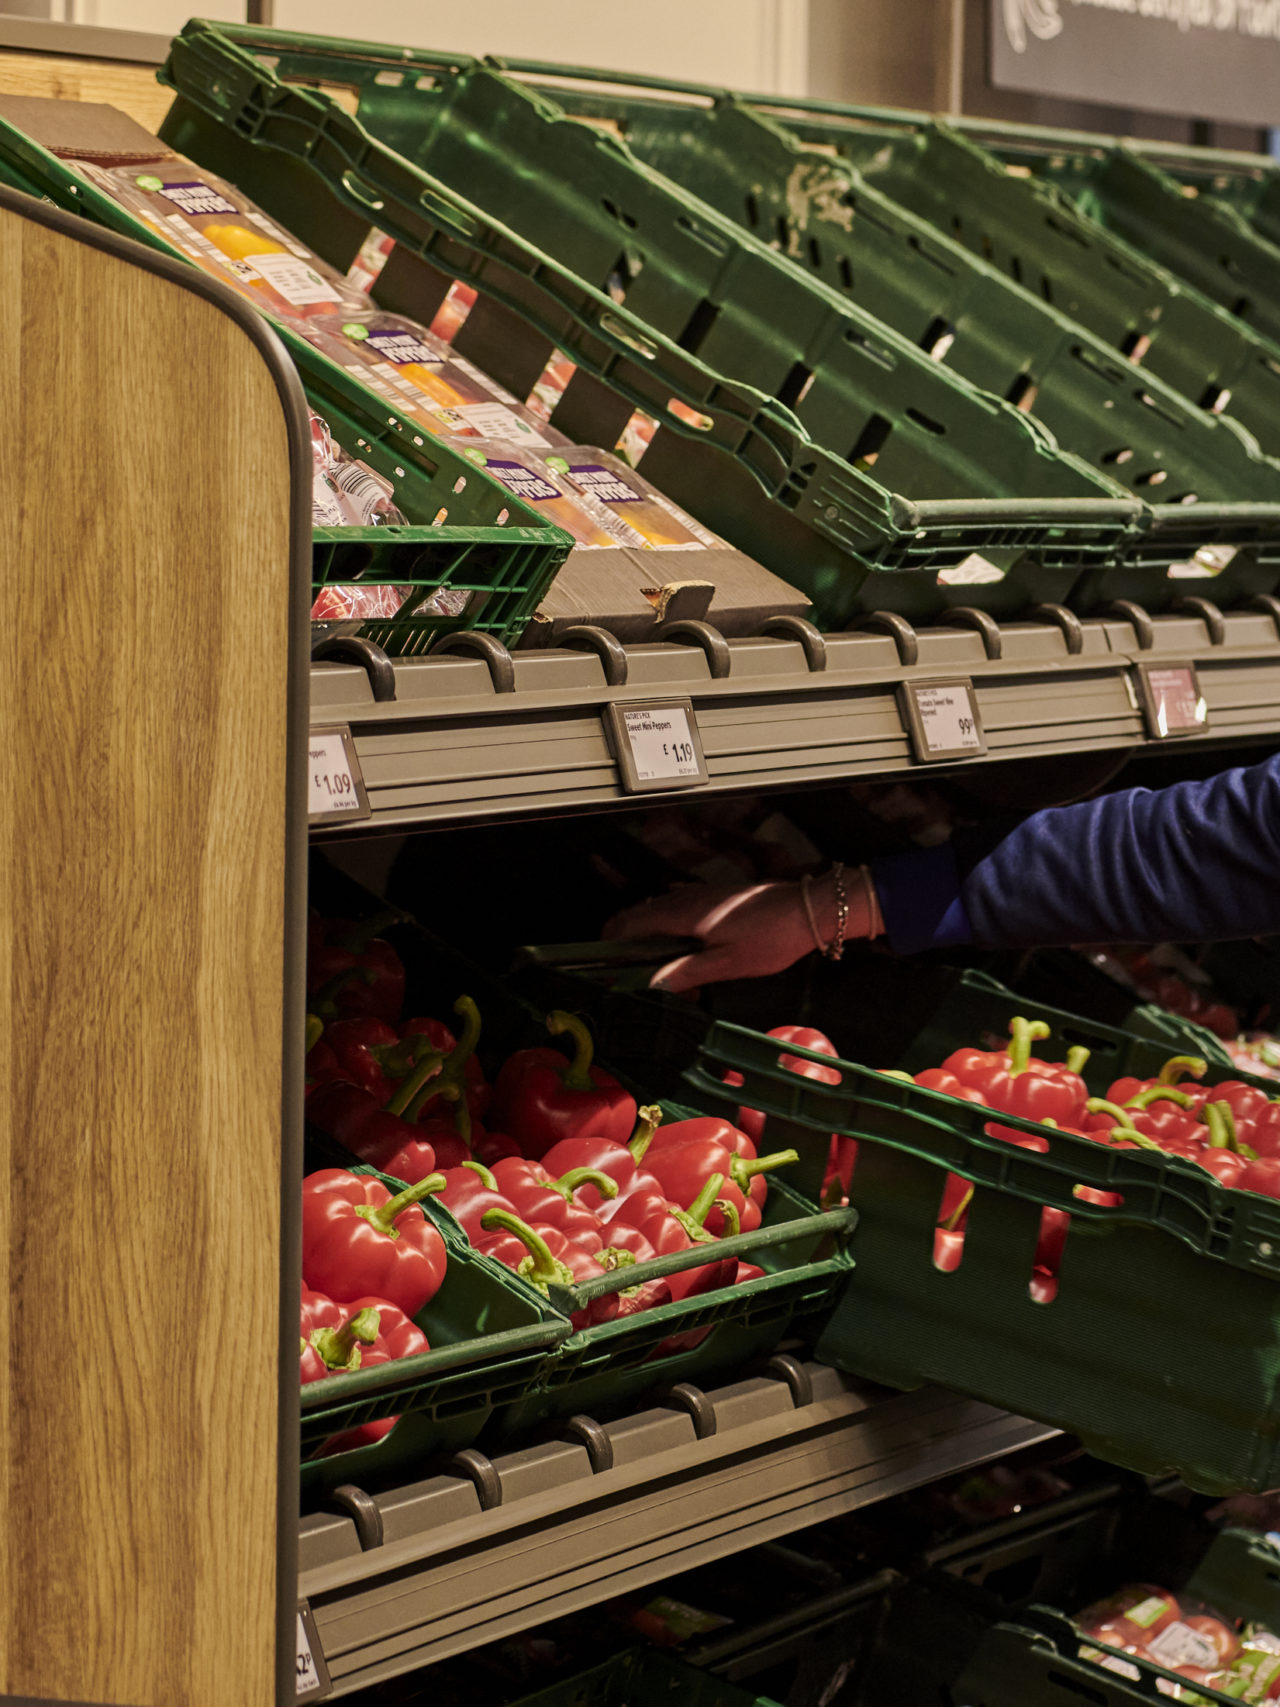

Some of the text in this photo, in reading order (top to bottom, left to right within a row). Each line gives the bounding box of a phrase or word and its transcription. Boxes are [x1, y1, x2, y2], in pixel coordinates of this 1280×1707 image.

[627, 721, 672, 732] Sweet Mini Peppers
